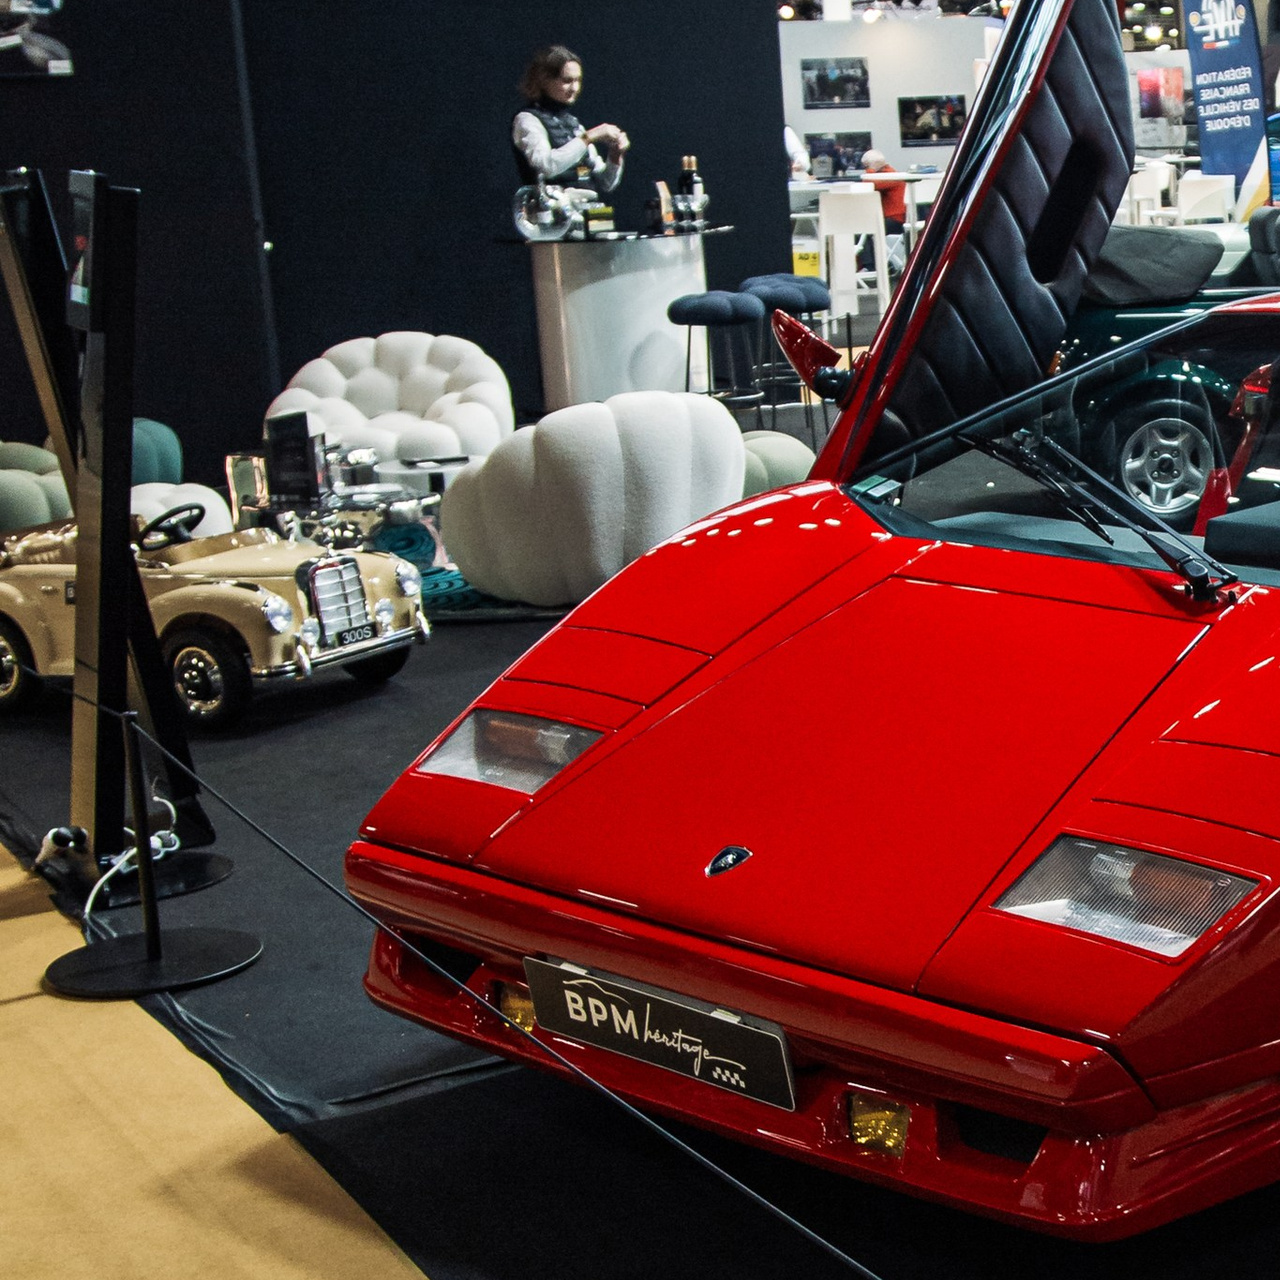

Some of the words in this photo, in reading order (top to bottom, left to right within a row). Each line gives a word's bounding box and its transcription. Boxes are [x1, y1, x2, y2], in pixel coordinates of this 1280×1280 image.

[342, 626, 372, 644] 300S
[564, 989, 639, 1040] BPM
[643, 1002, 746, 1076] héritage
